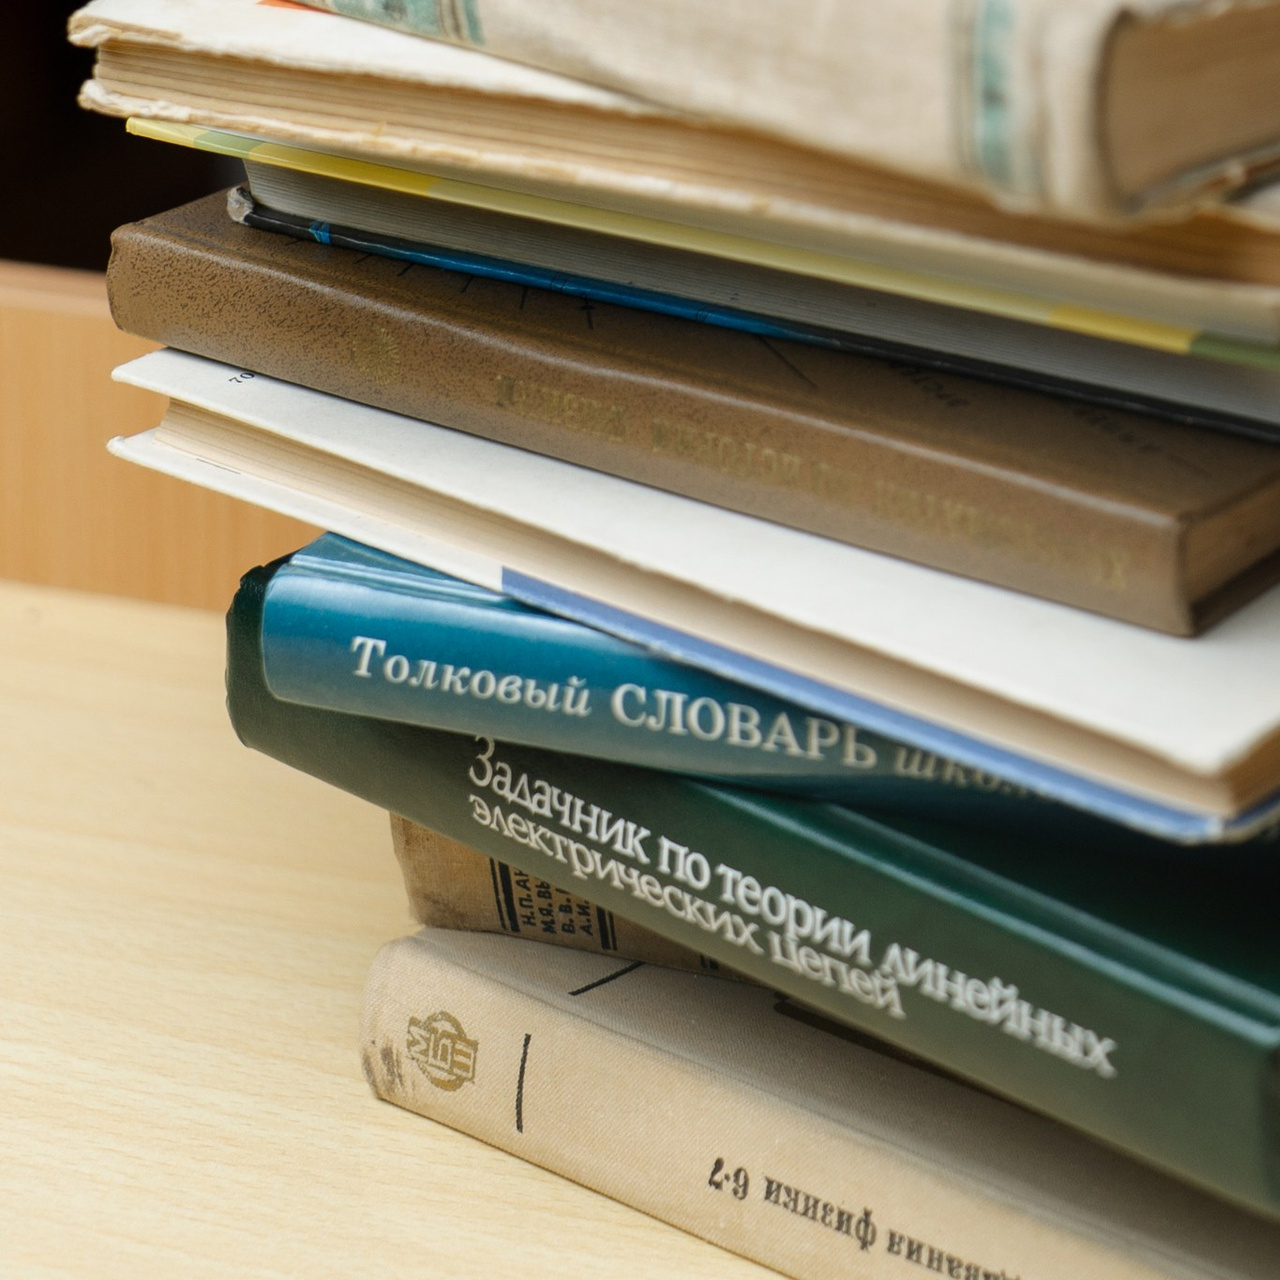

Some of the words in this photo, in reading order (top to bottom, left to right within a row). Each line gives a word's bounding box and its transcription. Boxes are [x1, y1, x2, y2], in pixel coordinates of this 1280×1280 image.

[351, 635, 592, 718] Толковый
[610, 682, 878, 770] СЛОВАРЬ
[895, 744, 1032, 798] шко
[468, 793, 765, 955] электрических
[768, 930, 908, 1021] цепей
[468, 735, 651, 865] Задачник
[657, 835, 712, 891] по
[714, 862, 873, 968] теории
[880, 941, 1119, 1080] линейных
[763, 1176, 877, 1251] физики
[886, 1229, 1020, 1280] вания
